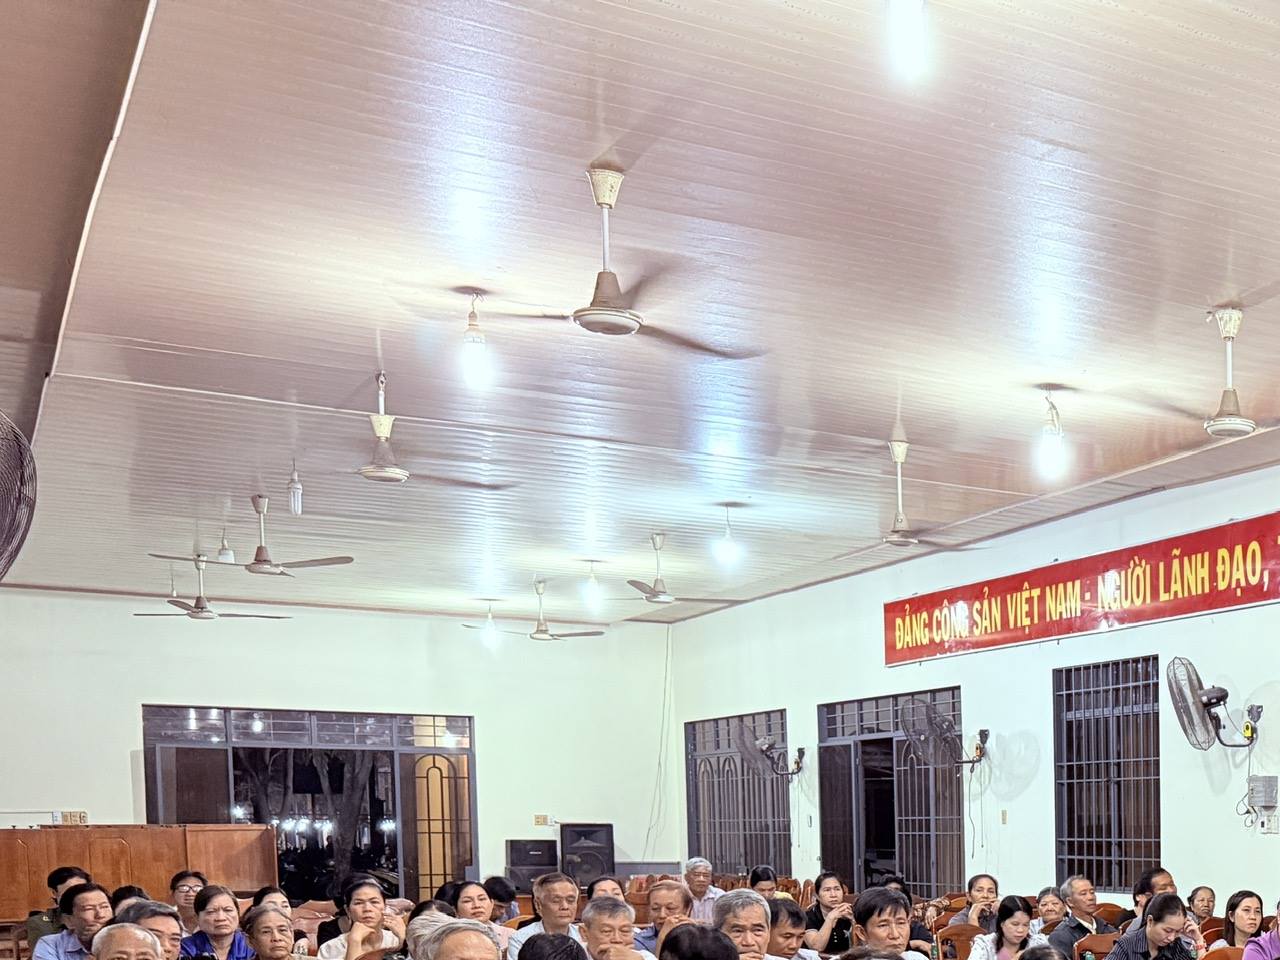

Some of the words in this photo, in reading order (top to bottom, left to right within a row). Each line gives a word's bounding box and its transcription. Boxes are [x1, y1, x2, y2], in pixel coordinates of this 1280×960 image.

[895, 604, 929, 649] ĐẢNG
[973, 586, 1001, 636] SẢN
[1007, 581, 1041, 634] VIỆT
[1046, 580, 1081, 622] NAM
[1097, 555, 1151, 612] NGƯỜI
[1159, 547, 1210, 602] LÃNH
[1216, 540, 1269, 597] ĐẠO,
